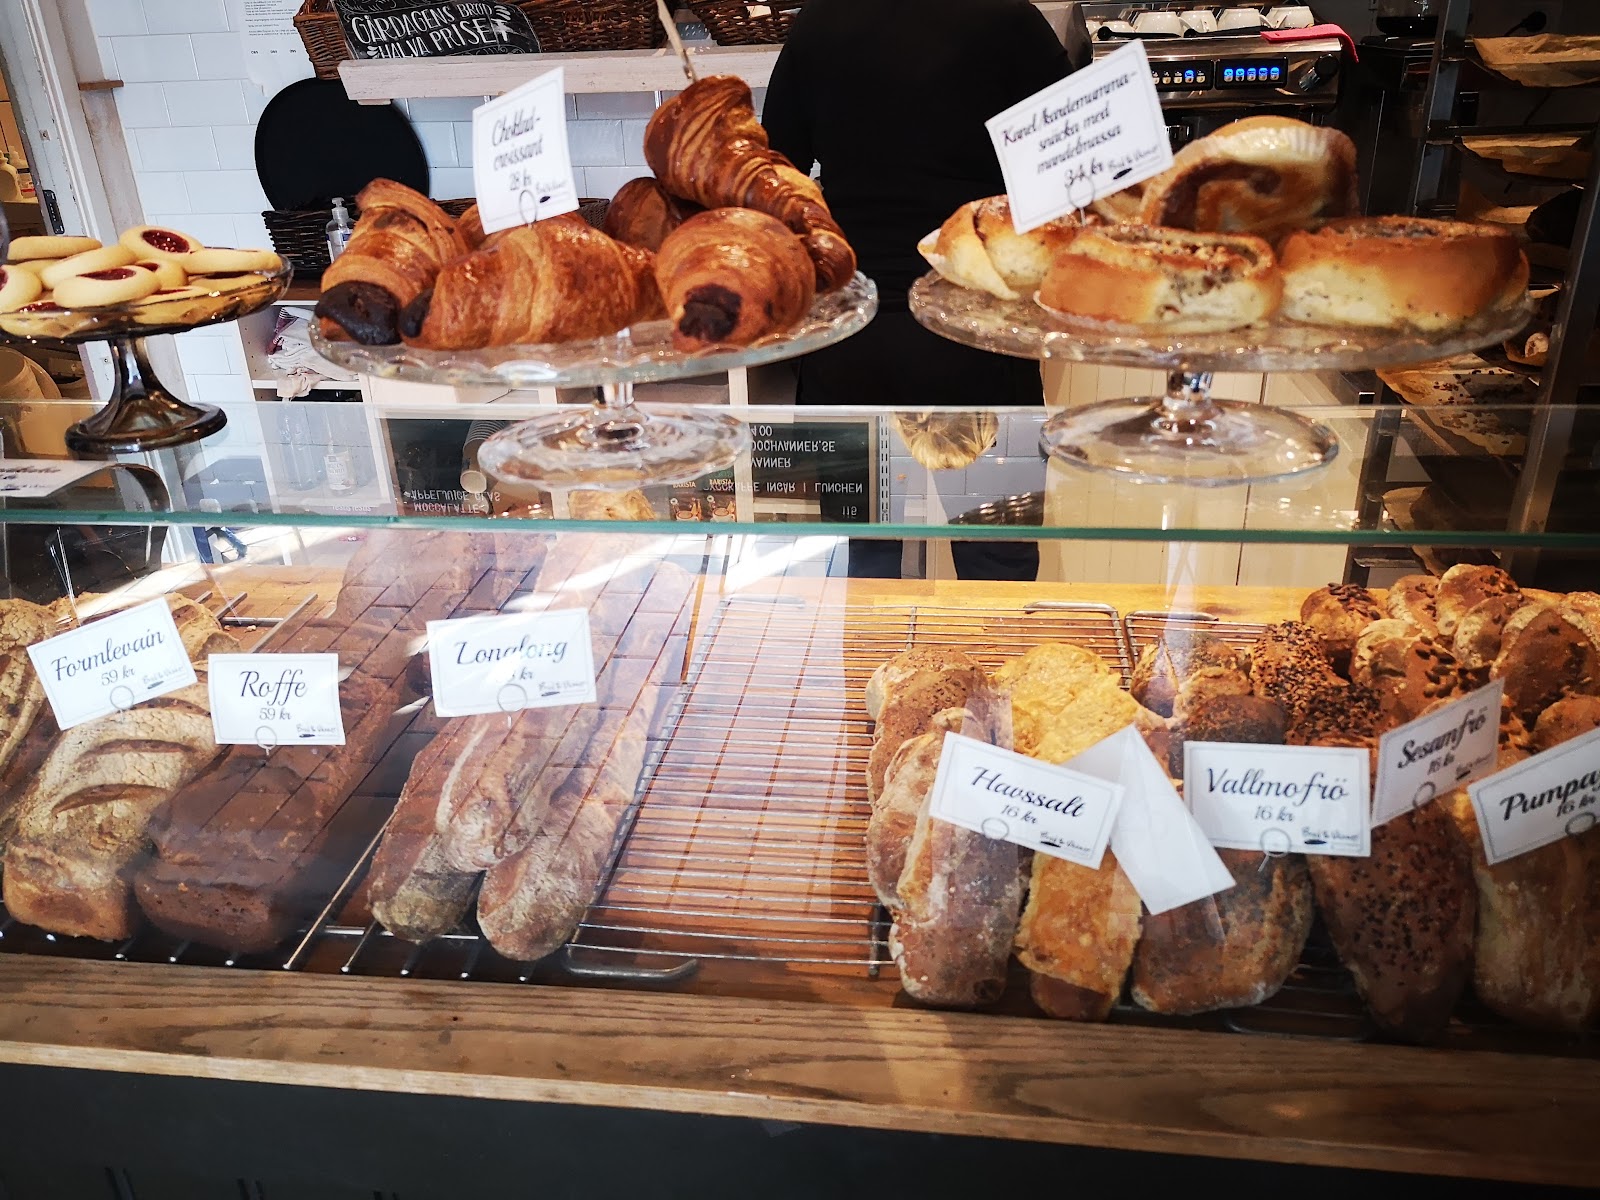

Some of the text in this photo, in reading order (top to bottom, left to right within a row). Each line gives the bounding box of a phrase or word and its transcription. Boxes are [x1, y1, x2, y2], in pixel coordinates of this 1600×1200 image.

[352, 6, 455, 44] GÅRDAGENS
[378, 37, 431, 58] HALVA
[1083, 100, 1109, 128] med
[1065, 164, 1085, 188] 34
[1091, 158, 1103, 175] kr
[51, 629, 165, 681] Formlevain
[101, 669, 119, 686] 59
[122, 665, 136, 678] kr
[239, 668, 308, 706] Roffe
[520, 667, 533, 680] kr
[259, 707, 292, 720] 59 kr
[1398, 706, 1488, 768] Sesamfrö
[971, 766, 1086, 818] Havssalt
[1206, 768, 1350, 807] Vallmofrö
[1500, 770, 1600, 821] Pumpa
[1001, 804, 1038, 824] 16 kr
[1254, 805, 1295, 822] 16 kr
[1556, 794, 1596, 817] 16 kr
